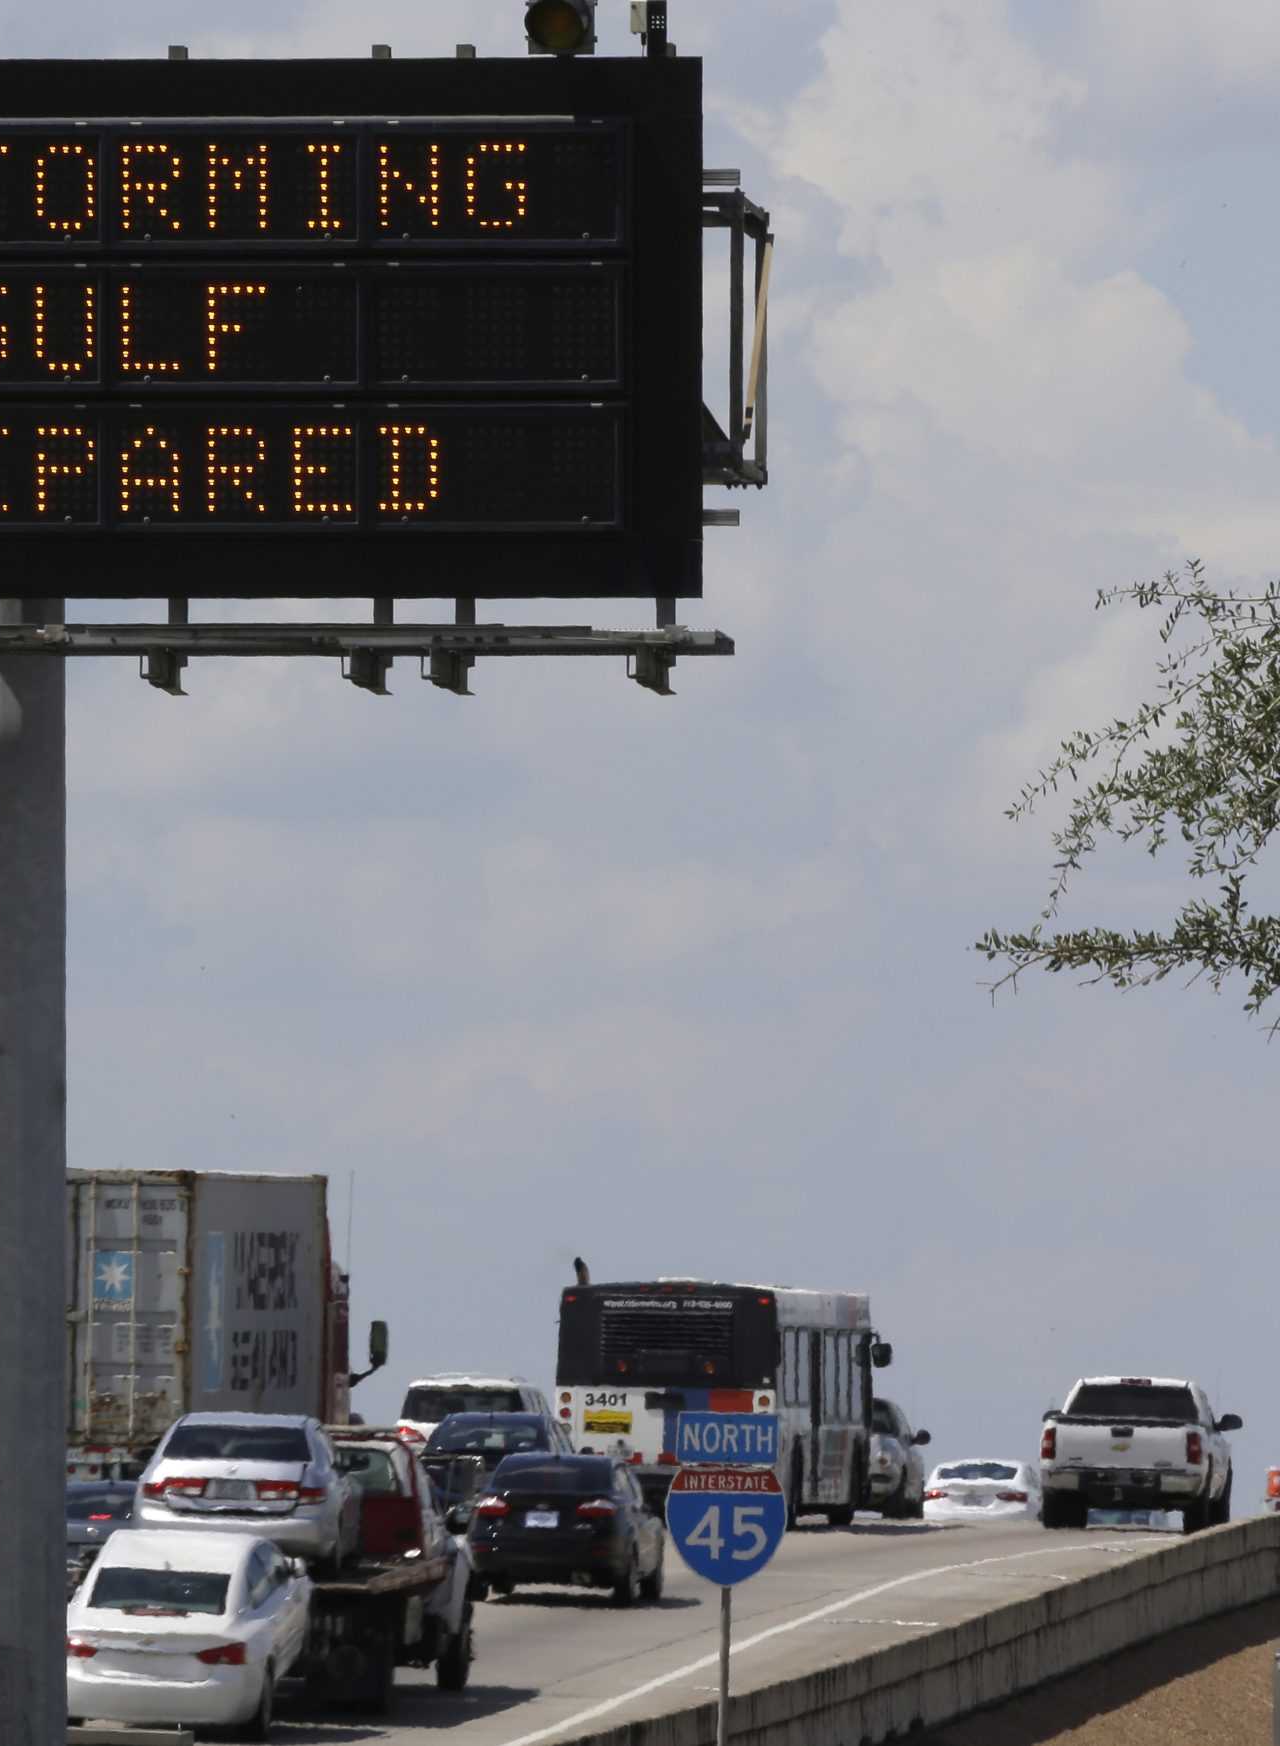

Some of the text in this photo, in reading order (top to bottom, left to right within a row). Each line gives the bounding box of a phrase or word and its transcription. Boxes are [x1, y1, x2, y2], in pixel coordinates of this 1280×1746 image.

[585, 1392, 628, 1407] 3401
[683, 1422, 774, 1454] NORTH
[683, 1473, 770, 1491] INTERSTATE
[685, 1504, 769, 1561] 45
